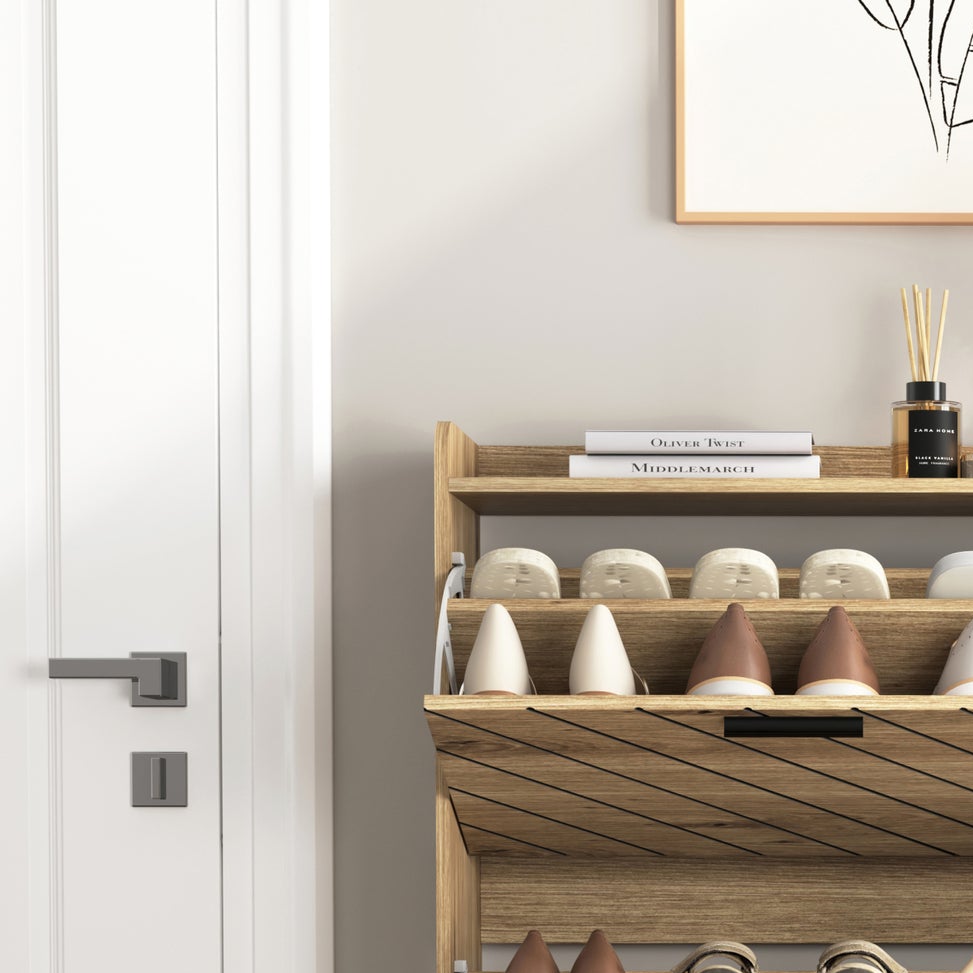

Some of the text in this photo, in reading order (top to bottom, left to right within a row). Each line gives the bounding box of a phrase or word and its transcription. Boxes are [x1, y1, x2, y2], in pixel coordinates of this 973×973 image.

[651, 438, 745, 448] OLIVER TWIST
[631, 463, 755, 473] MIDDLEMARCH
